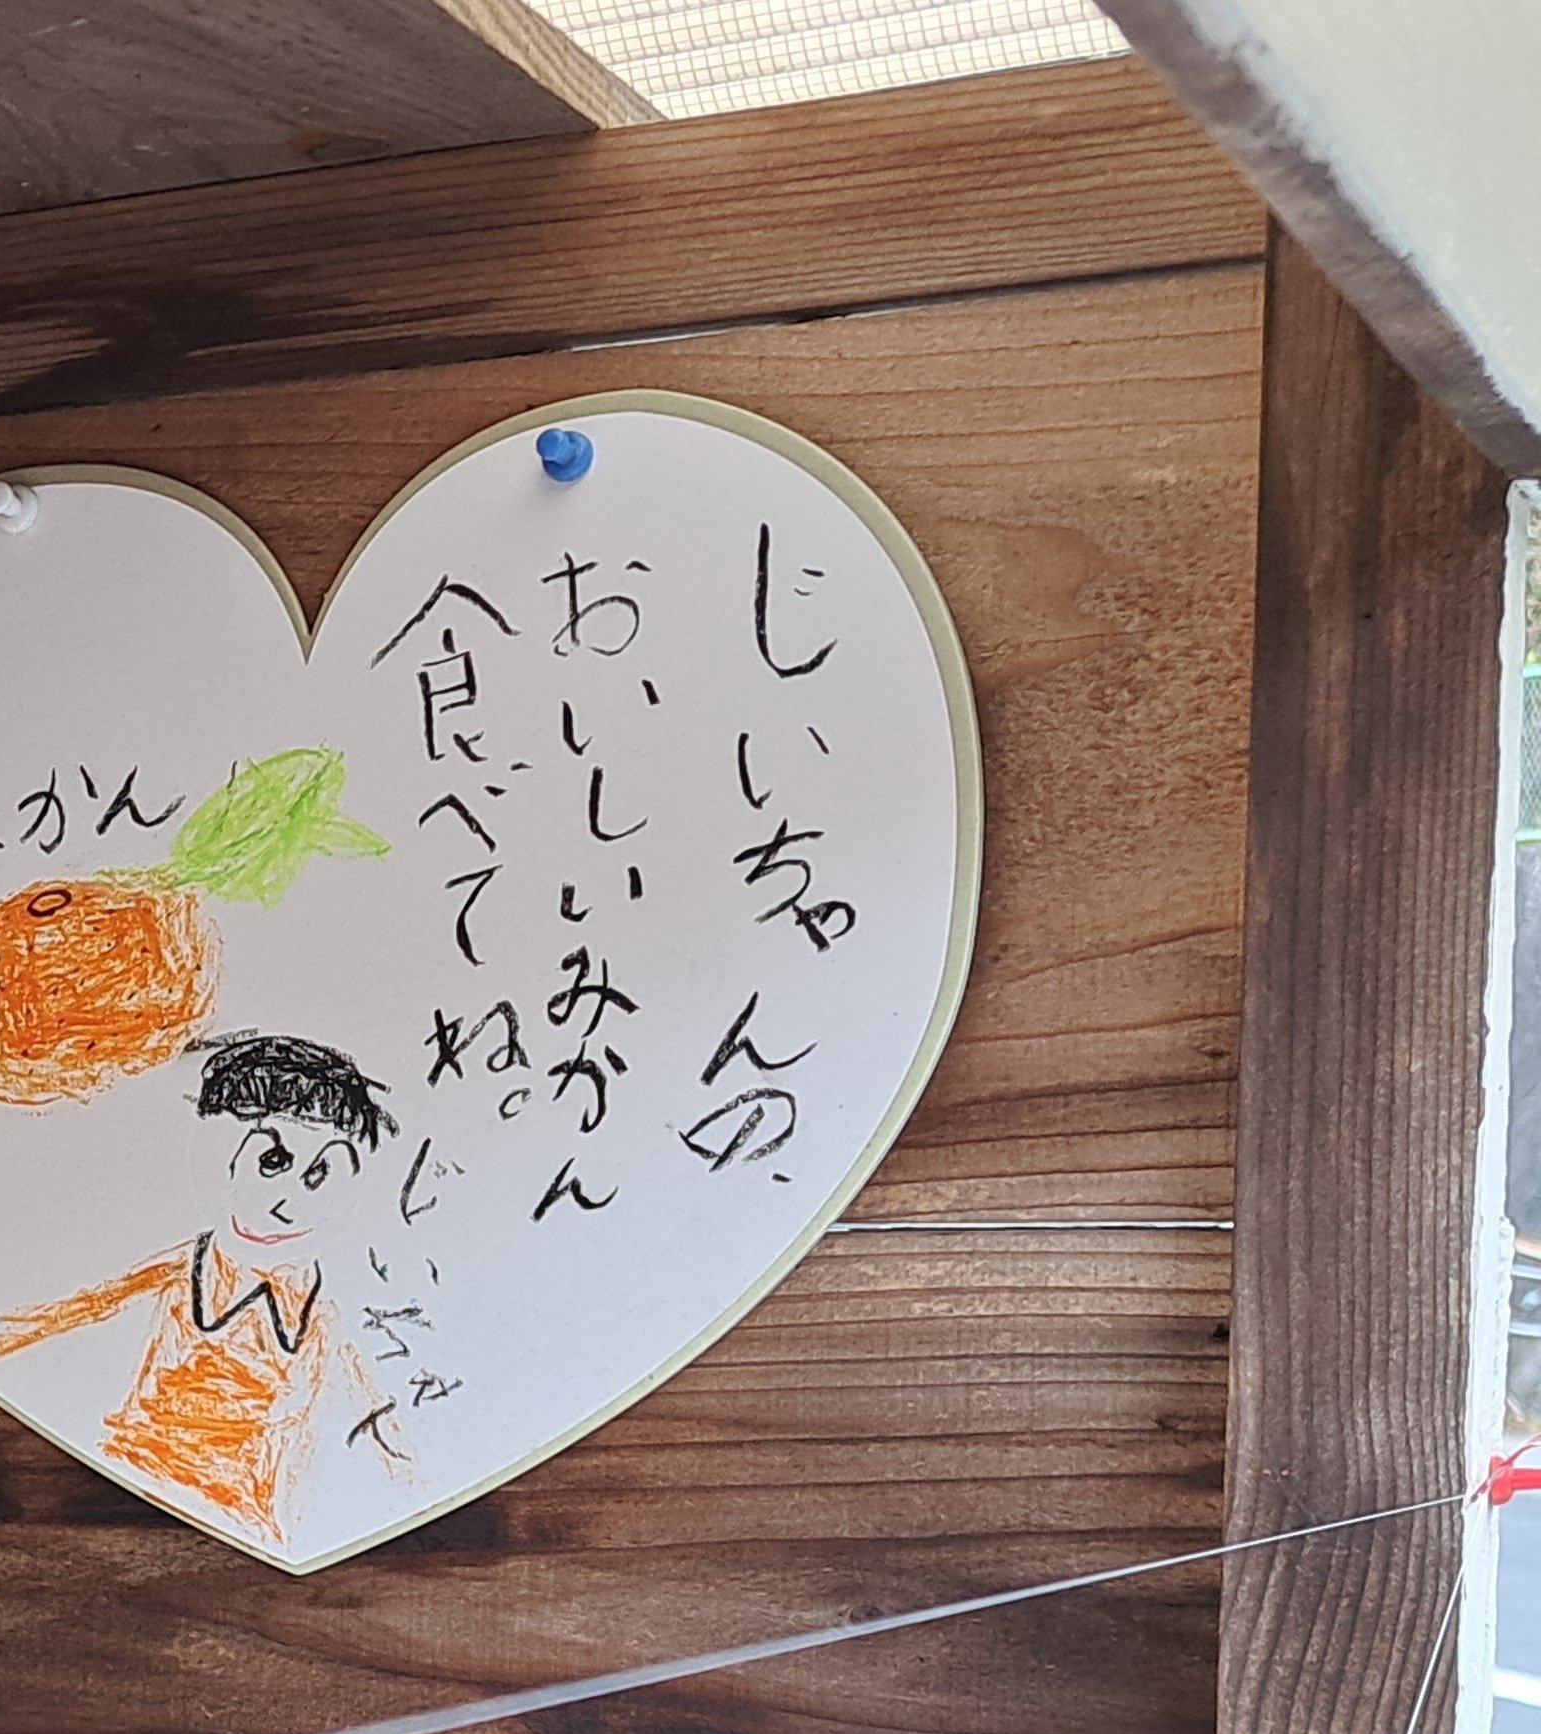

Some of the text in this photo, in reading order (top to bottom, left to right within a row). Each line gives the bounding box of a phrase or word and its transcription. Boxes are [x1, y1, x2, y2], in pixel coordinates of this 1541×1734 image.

[531, 551, 660, 1223] おいしいみかん
